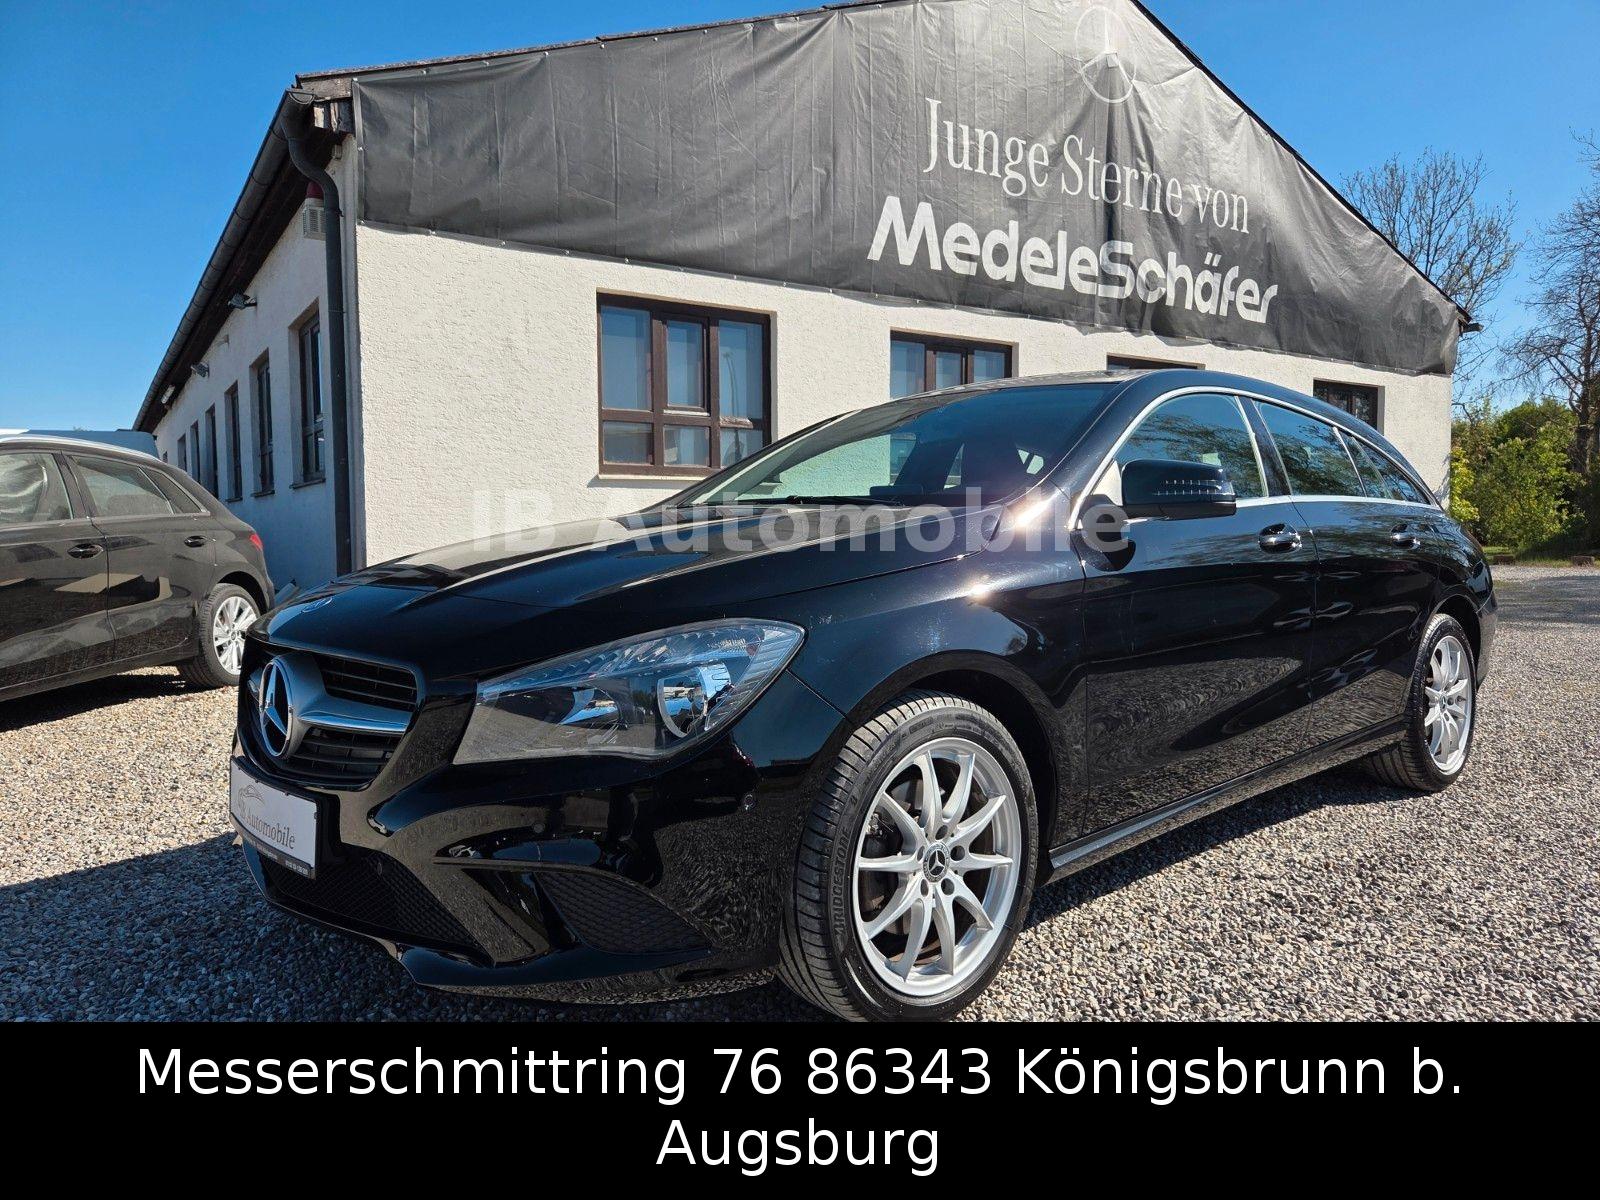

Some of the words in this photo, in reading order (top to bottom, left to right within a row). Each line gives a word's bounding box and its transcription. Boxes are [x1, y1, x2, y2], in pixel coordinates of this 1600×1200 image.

[923, 98, 1049, 196] Junge
[1060, 135, 1183, 218] Sterne
[1190, 183, 1250, 234] von
[867, 195, 1279, 324] MedeleSchäfer
